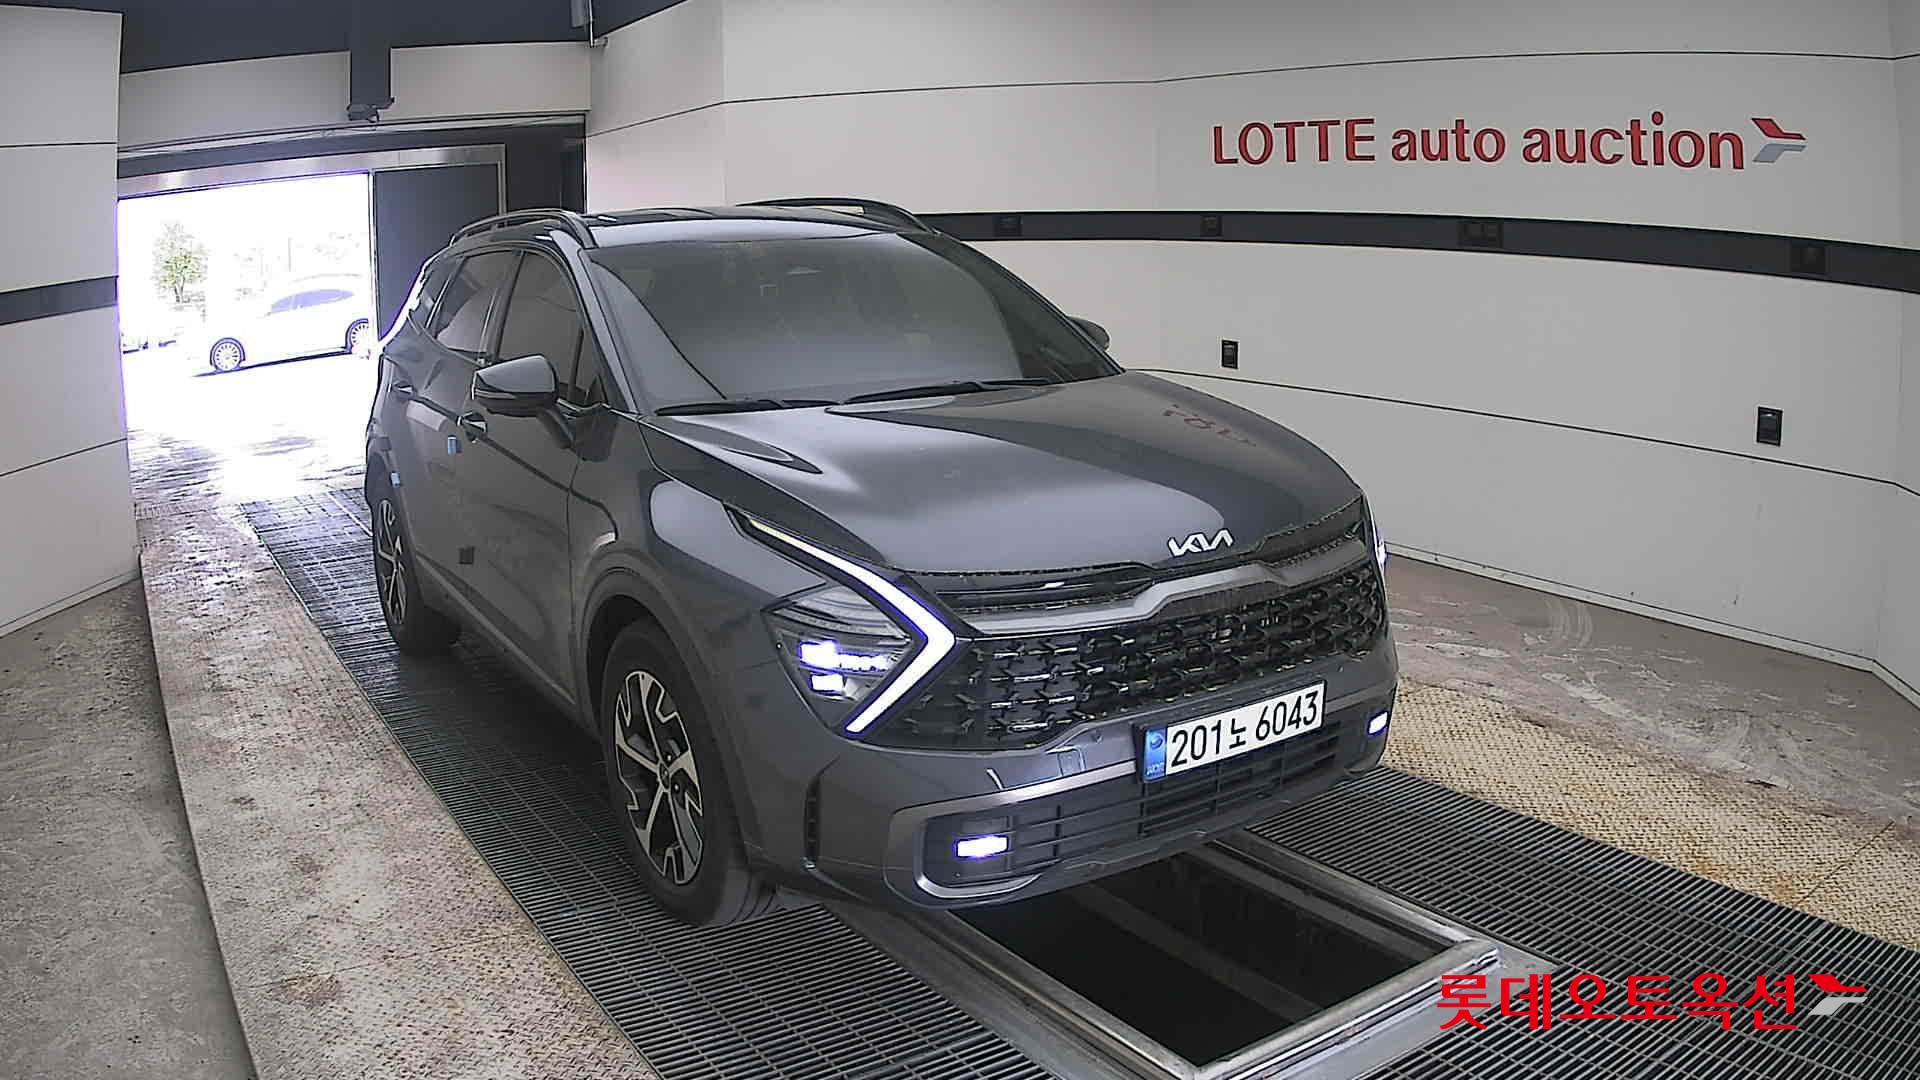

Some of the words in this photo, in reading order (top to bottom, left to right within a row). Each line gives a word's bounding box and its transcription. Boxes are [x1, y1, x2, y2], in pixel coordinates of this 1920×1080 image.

[1213, 118, 1376, 164] LOTTE
[1392, 119, 1506, 163] auto
[1522, 111, 1744, 169] auction
[1171, 718, 1247, 768] 201노
[1255, 690, 1319, 742] 6043
